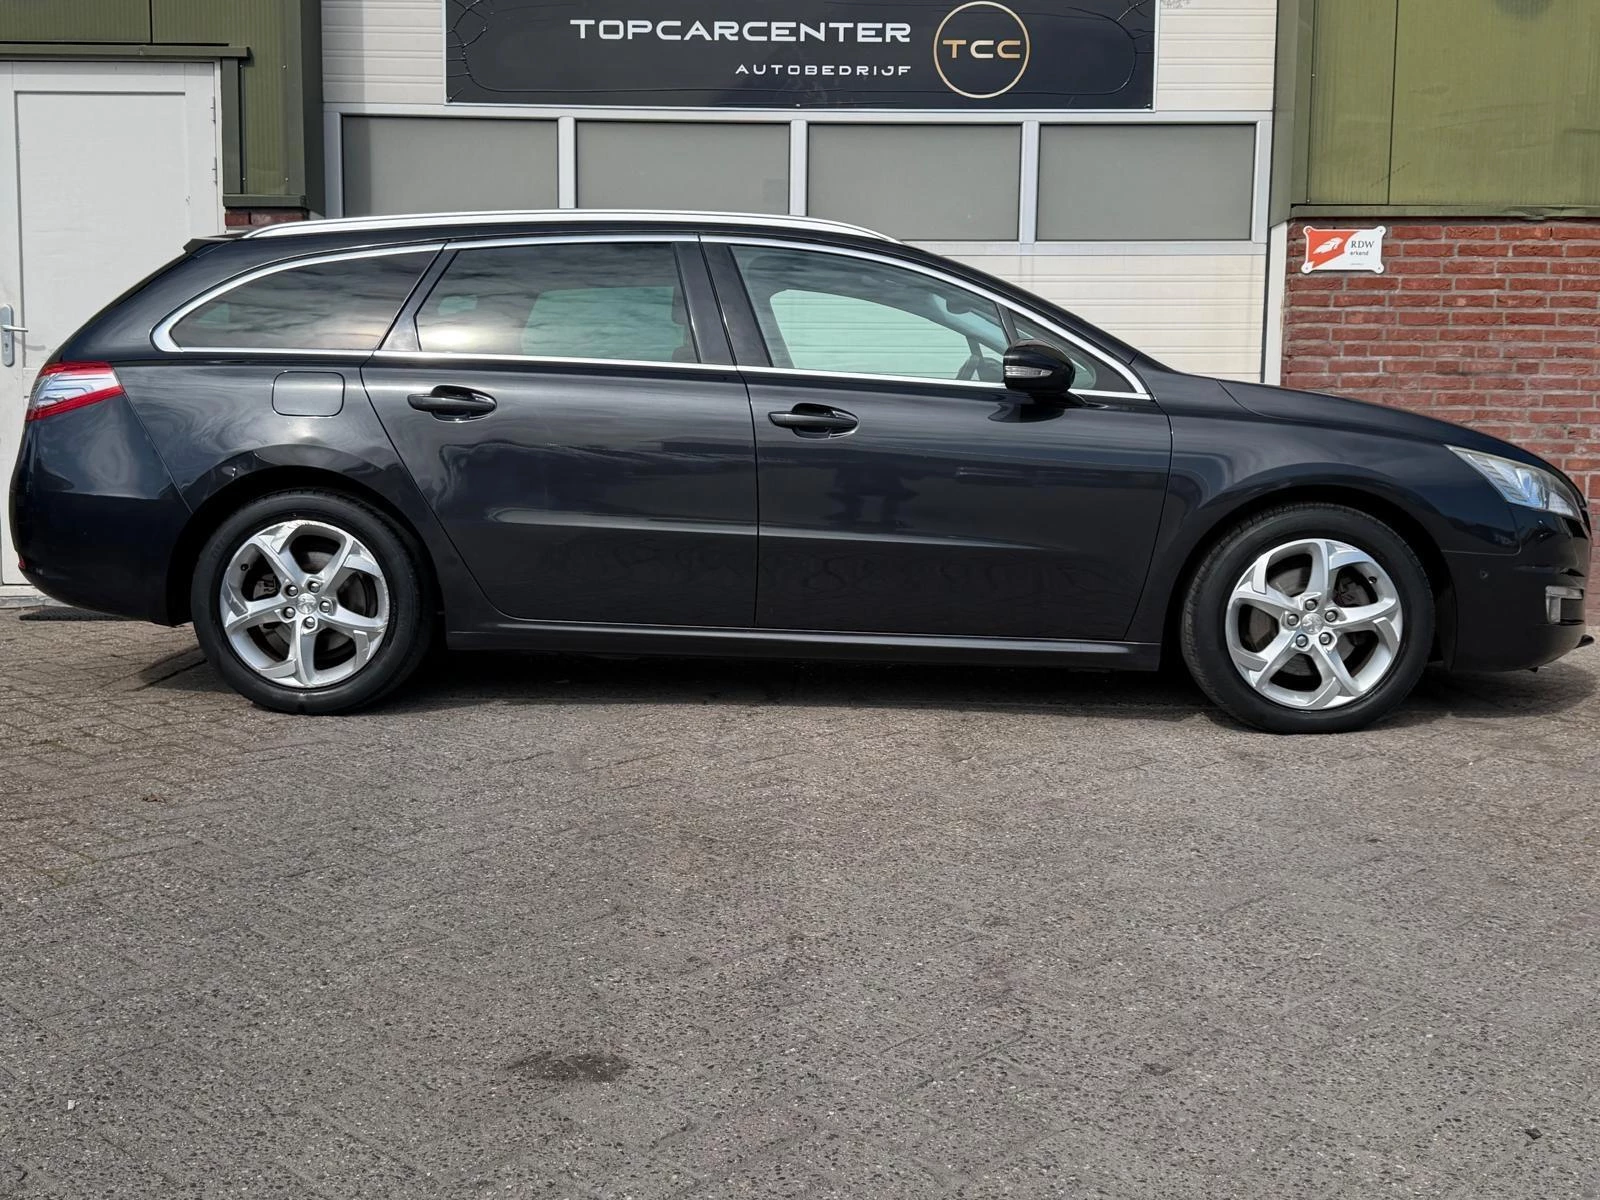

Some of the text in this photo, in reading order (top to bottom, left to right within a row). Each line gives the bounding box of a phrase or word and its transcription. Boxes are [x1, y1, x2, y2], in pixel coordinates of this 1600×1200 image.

[569, 19, 912, 43] TOPCARCENTER
[943, 39, 1022, 59] TCC
[735, 64, 912, 76] AUTOBEDRIJF
[1350, 240, 1375, 249] RDW
